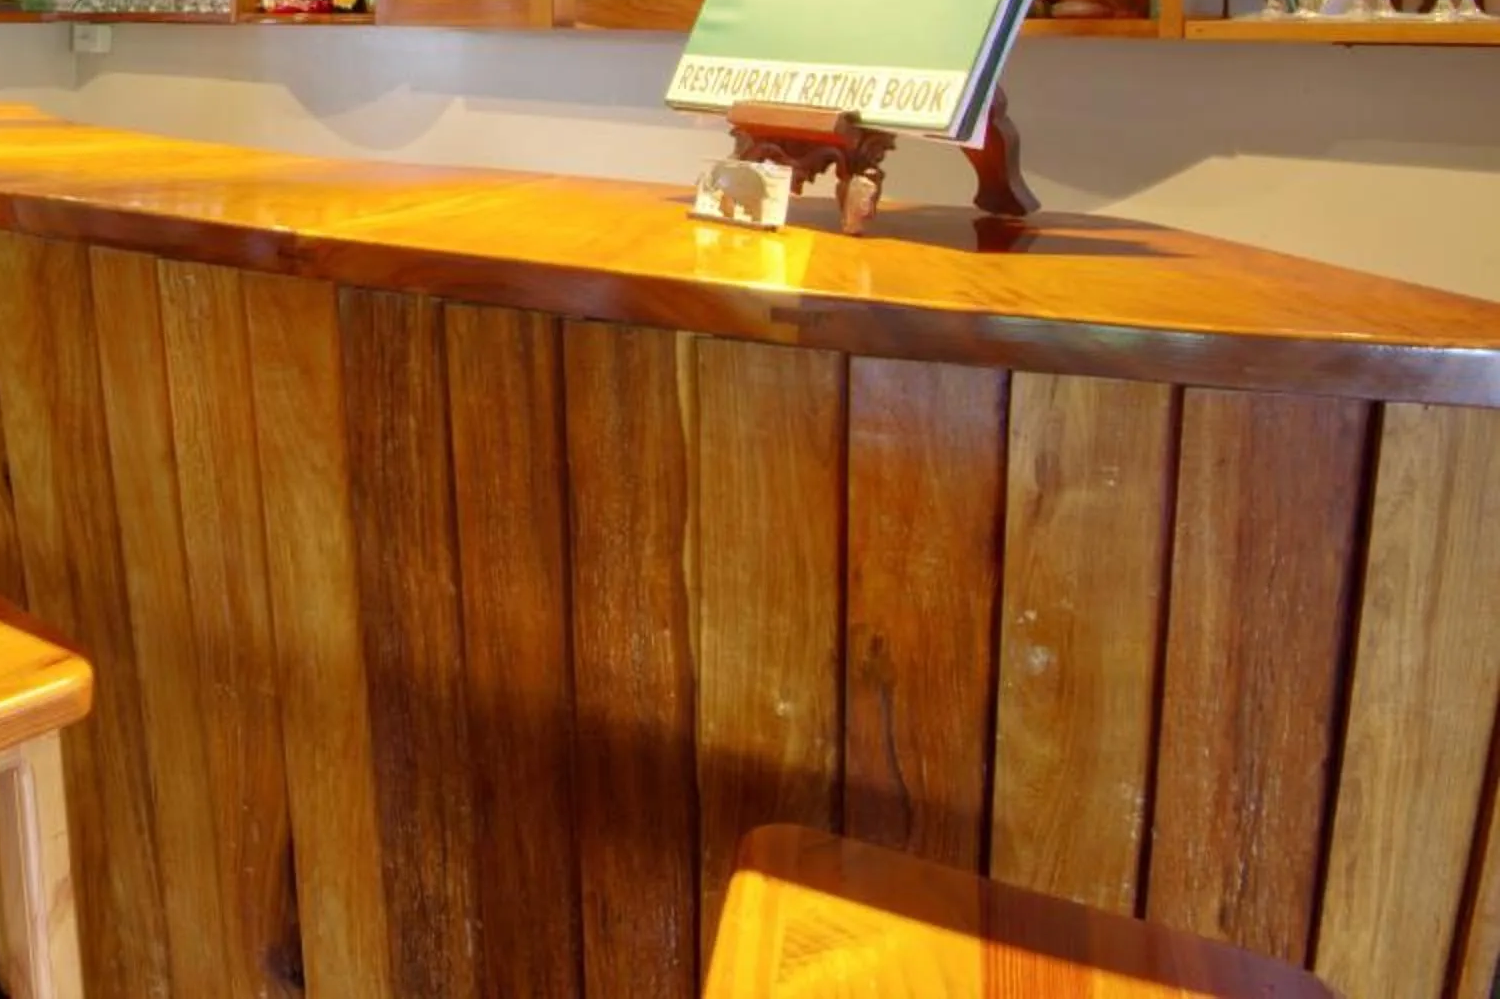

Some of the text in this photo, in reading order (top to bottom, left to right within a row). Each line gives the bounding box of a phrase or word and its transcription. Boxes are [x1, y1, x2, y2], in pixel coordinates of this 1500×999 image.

[678, 64, 951, 112] RESTAURANT RATING BOOK
